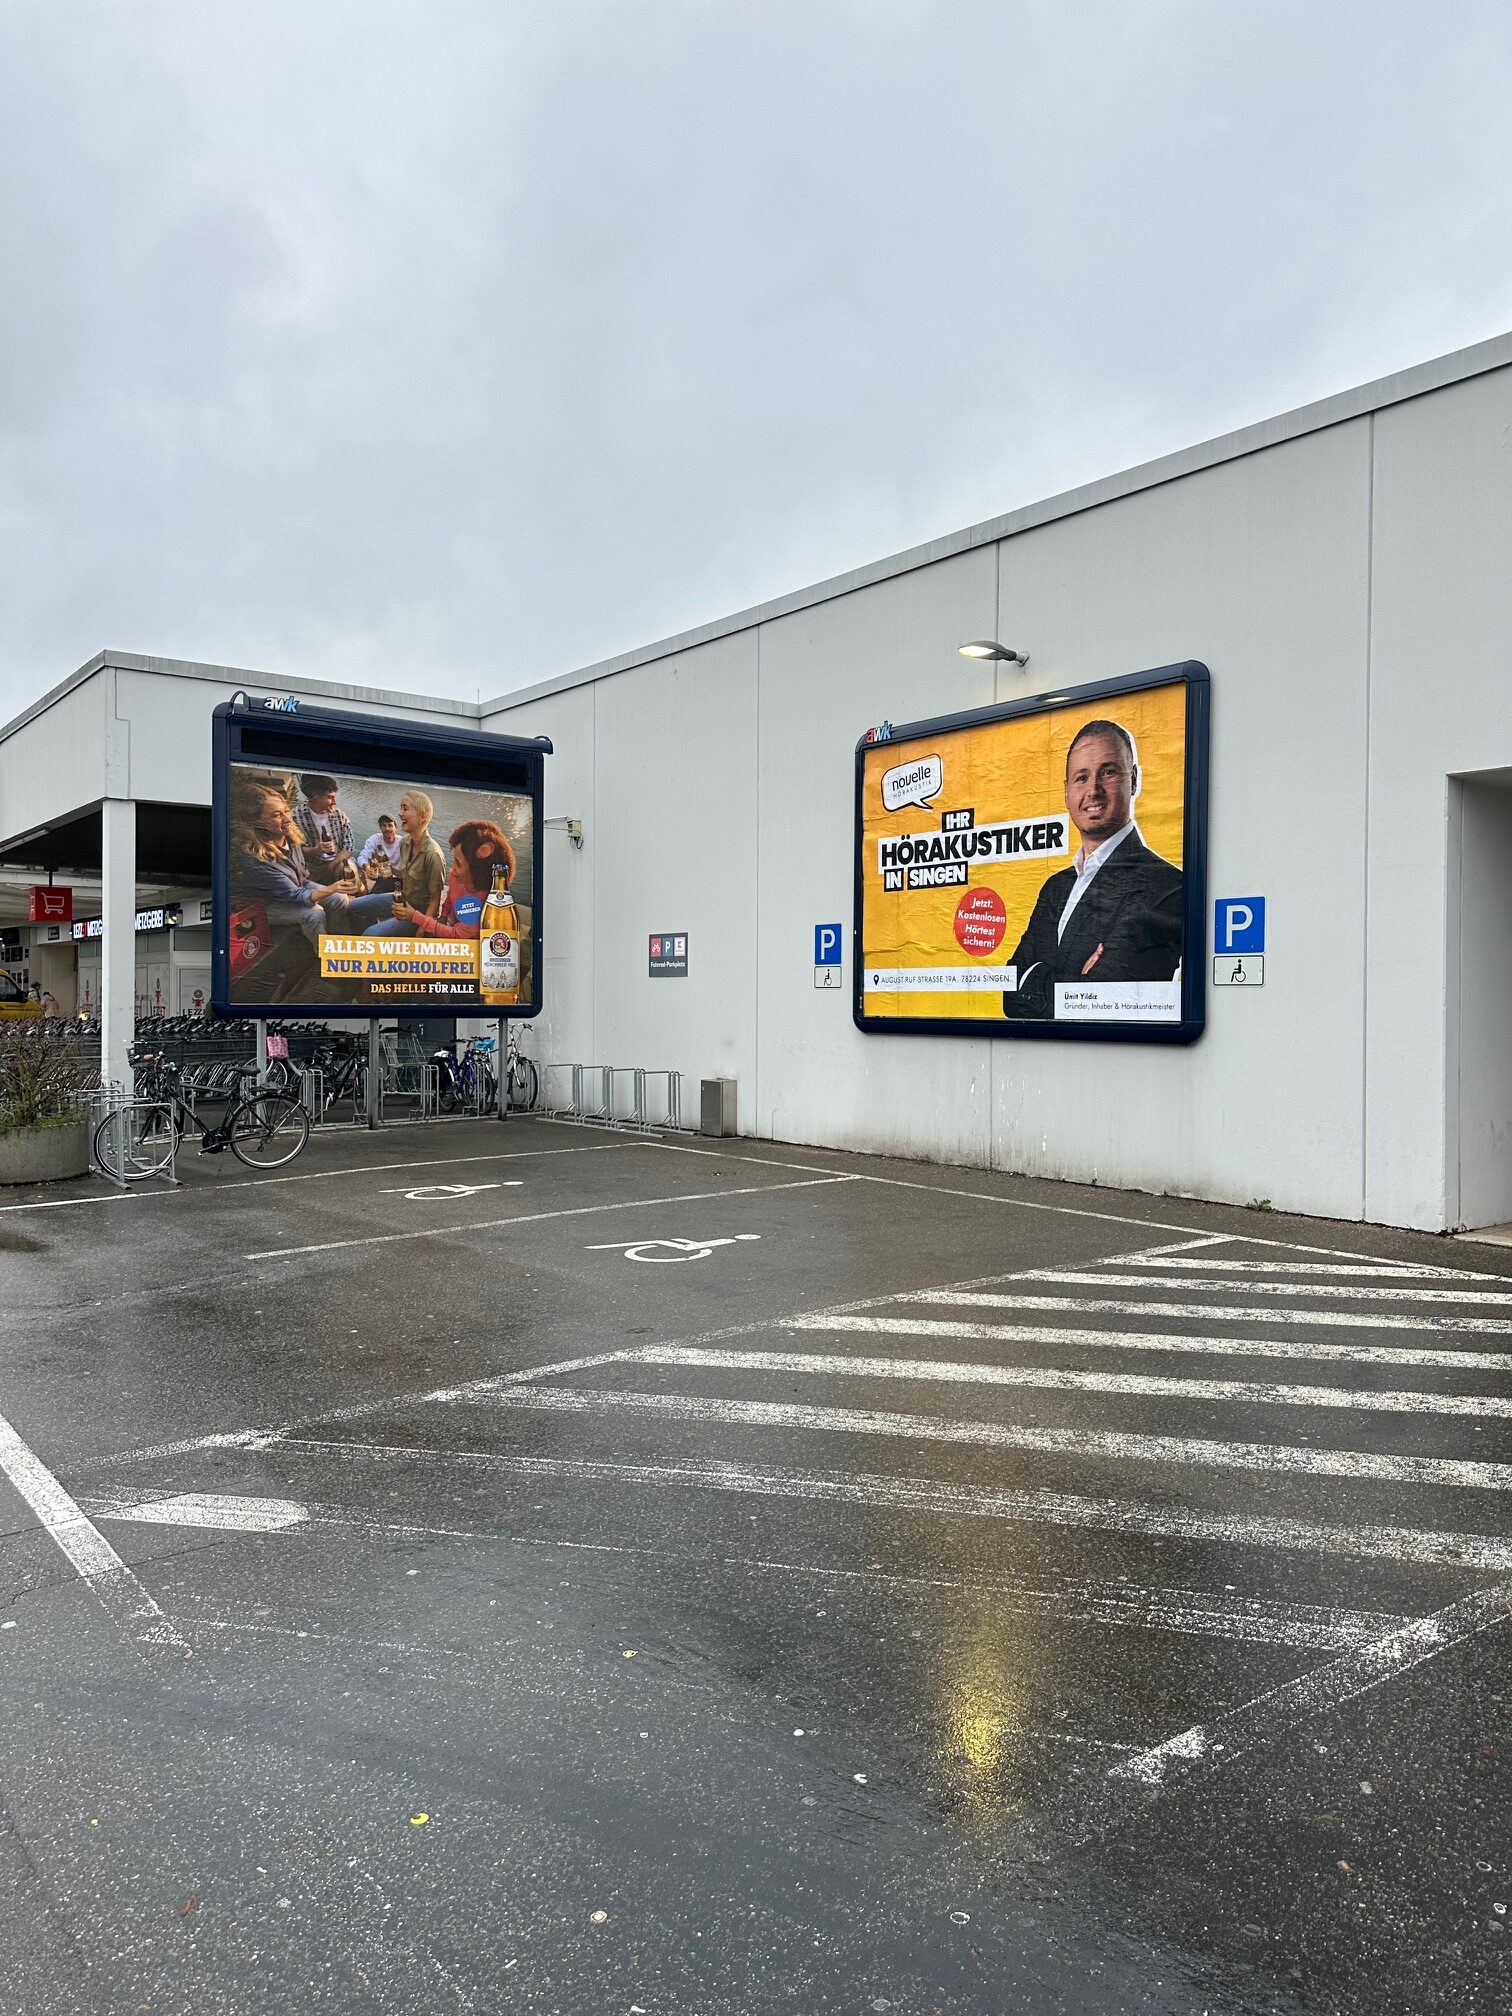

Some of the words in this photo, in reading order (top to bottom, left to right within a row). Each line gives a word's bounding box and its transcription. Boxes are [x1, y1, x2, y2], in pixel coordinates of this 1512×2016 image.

[264, 696, 300, 712] awk
[866, 720, 893, 744] awk
[892, 766, 931, 791] novelle
[893, 780, 932, 799] HÖRAKUSTIK
[945, 812, 971, 830] IHR
[881, 822, 1064, 867] HÖRAKUSTIKER
[886, 870, 902, 889] IN
[909, 865, 966, 887] SINGEN
[971, 897, 994, 909] Jetzt:
[957, 909, 1006, 923] Kostenlosen
[965, 923, 996, 936] Hörtest
[1226, 905, 1253, 947] P
[324, 939, 375, 955] ALLES
[378, 941, 411, 955] WIE
[414, 943, 475, 958] IMMER,
[821, 929, 835, 960] P
[963, 936, 995, 949] sichern!
[326, 959, 362, 973] NUR
[366, 960, 475, 975] ALKOHOLFREI
[961, 974, 981, 983] 78224
[370, 983, 392, 994] DAS
[393, 983, 427, 994] HELLE
[428, 982, 449, 994] FÜR
[450, 984, 475, 994] ALLE
[1064, 1002, 1090, 1011] Gründer,
[1091, 1002, 1113, 1010] Inhaber
[1121, 1002, 1175, 1011] Hörakustikmeister
